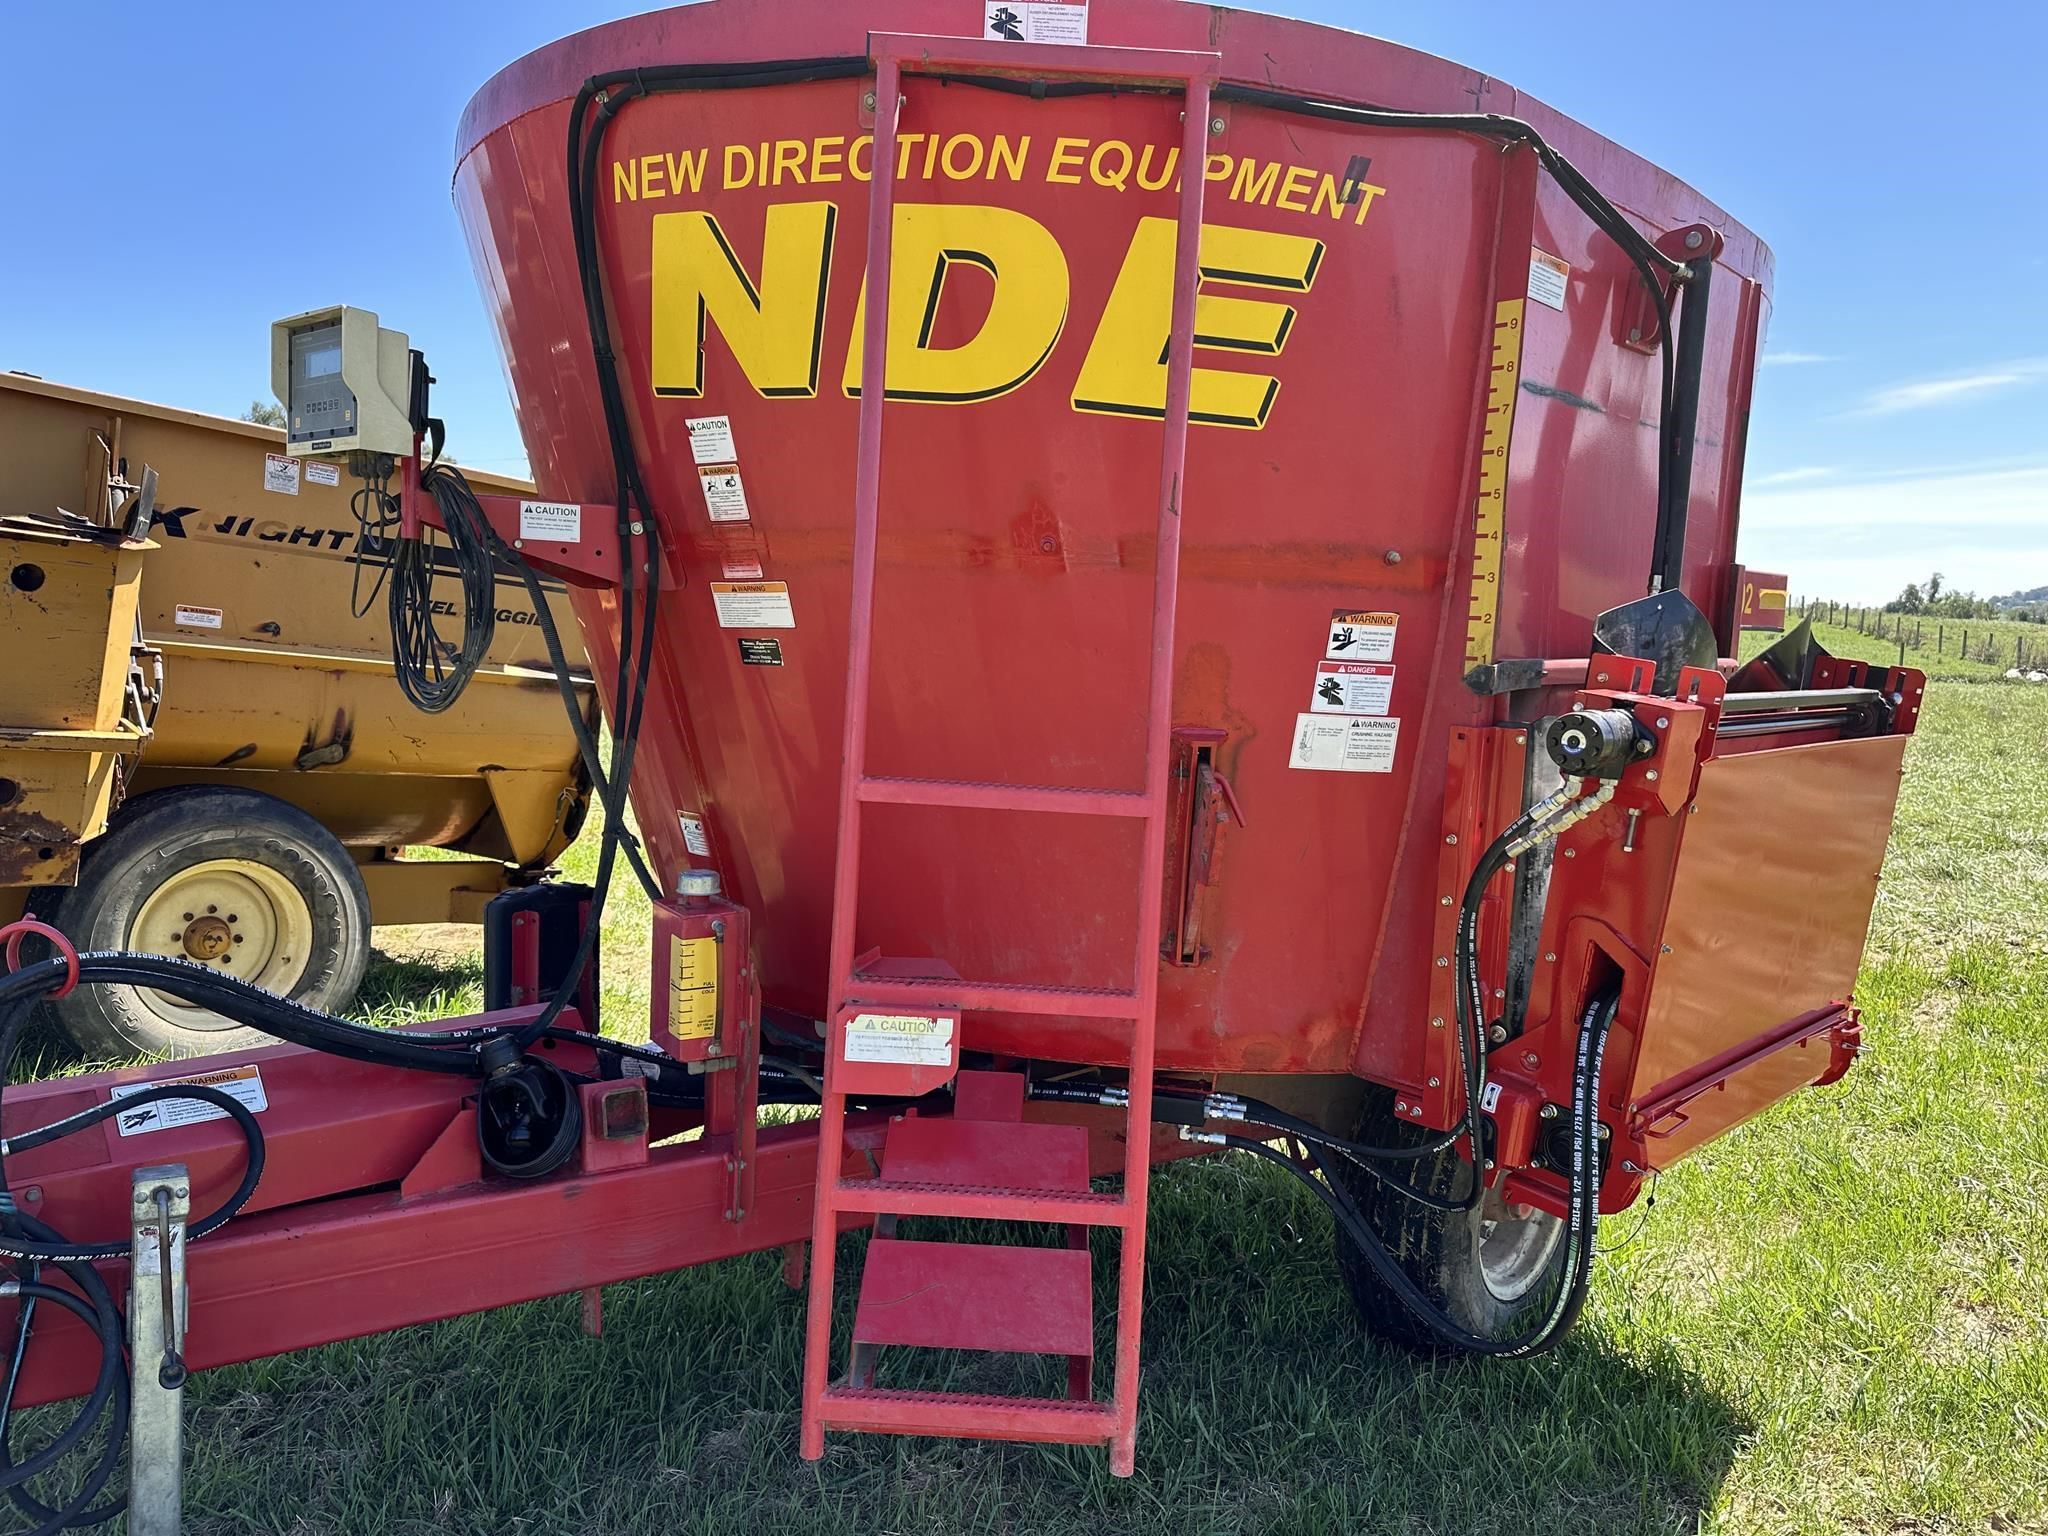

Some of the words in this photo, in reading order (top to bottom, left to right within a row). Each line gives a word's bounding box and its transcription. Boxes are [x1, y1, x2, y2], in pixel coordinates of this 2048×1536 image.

[613, 148, 708, 203] NEW
[723, 133, 1031, 190] DIRECTION
[651, 200, 1326, 430] NDE
[1510, 318, 1518, 329] 9
[1506, 361, 1514, 372] 8
[1502, 404, 1509, 414] 7
[696, 421, 727, 431] CAUTION
[1496, 446, 1504, 457] 6
[709, 467, 734, 475] WARNING
[1493, 488, 1501, 499] 5
[535, 506, 577, 517] CAUTION
[1490, 530, 1498, 541] 4
[1487, 572, 1495, 583] 3
[738, 585, 766, 593] WARNING
[1350, 615, 1393, 625] WARNING
[1483, 613, 1492, 624] 2
[1481, 654, 1487, 664] 1
[1347, 666, 1376, 674] DANGER
[1360, 720, 1397, 729] WARNING
[880, 1020, 935, 1033] CAUTION
[1583, 1015, 1594, 1029] MADE
[1579, 1031, 1590, 1054] 100R2AT
[1578, 1055, 1586, 1067] SAE
[187, 1072, 239, 1086] WARNING
[1575, 1087, 1584, 1099] WP
[1575, 1099, 1584, 1115] BAR
[1591, 1106, 1599, 1121] 275
[1574, 1116, 1582, 1131] 275
[1591, 1121, 1599, 1137] BAR
[1574, 1137, 1582, 1151] PSI
[1591, 1138, 1599, 1152] WP
[1574, 1152, 1582, 1172] 4000
[1573, 1176, 1582, 1193] 1/2"
[1571, 1197, 1582, 1232] 122LT-08
[1590, 1233, 1598, 1256] MADE
[1541, 1317, 1556, 1337] NOVA
[1561, 1259, 1575, 1301] BREAKER
